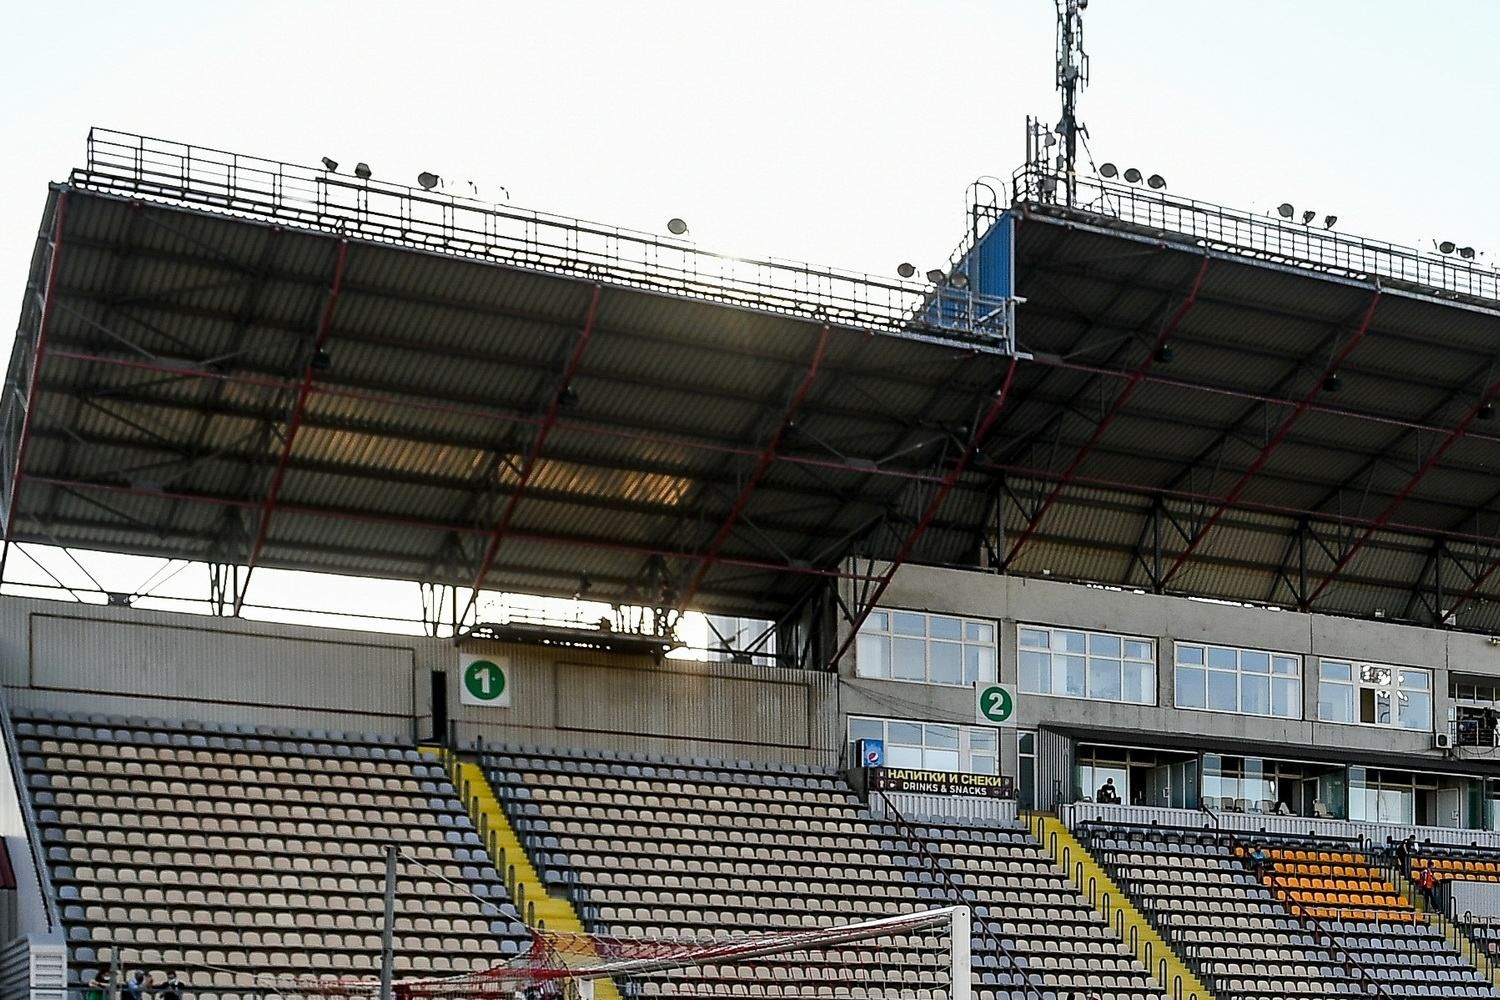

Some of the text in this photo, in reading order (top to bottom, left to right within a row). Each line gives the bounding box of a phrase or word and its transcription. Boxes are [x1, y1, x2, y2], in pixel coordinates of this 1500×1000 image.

[474, 668, 491, 694] 1
[988, 692, 1005, 716] 2
[887, 769, 1001, 788] НАПИТКИ И СНЕКИ
[902, 781, 987, 796] DRINKS & SNACKS
